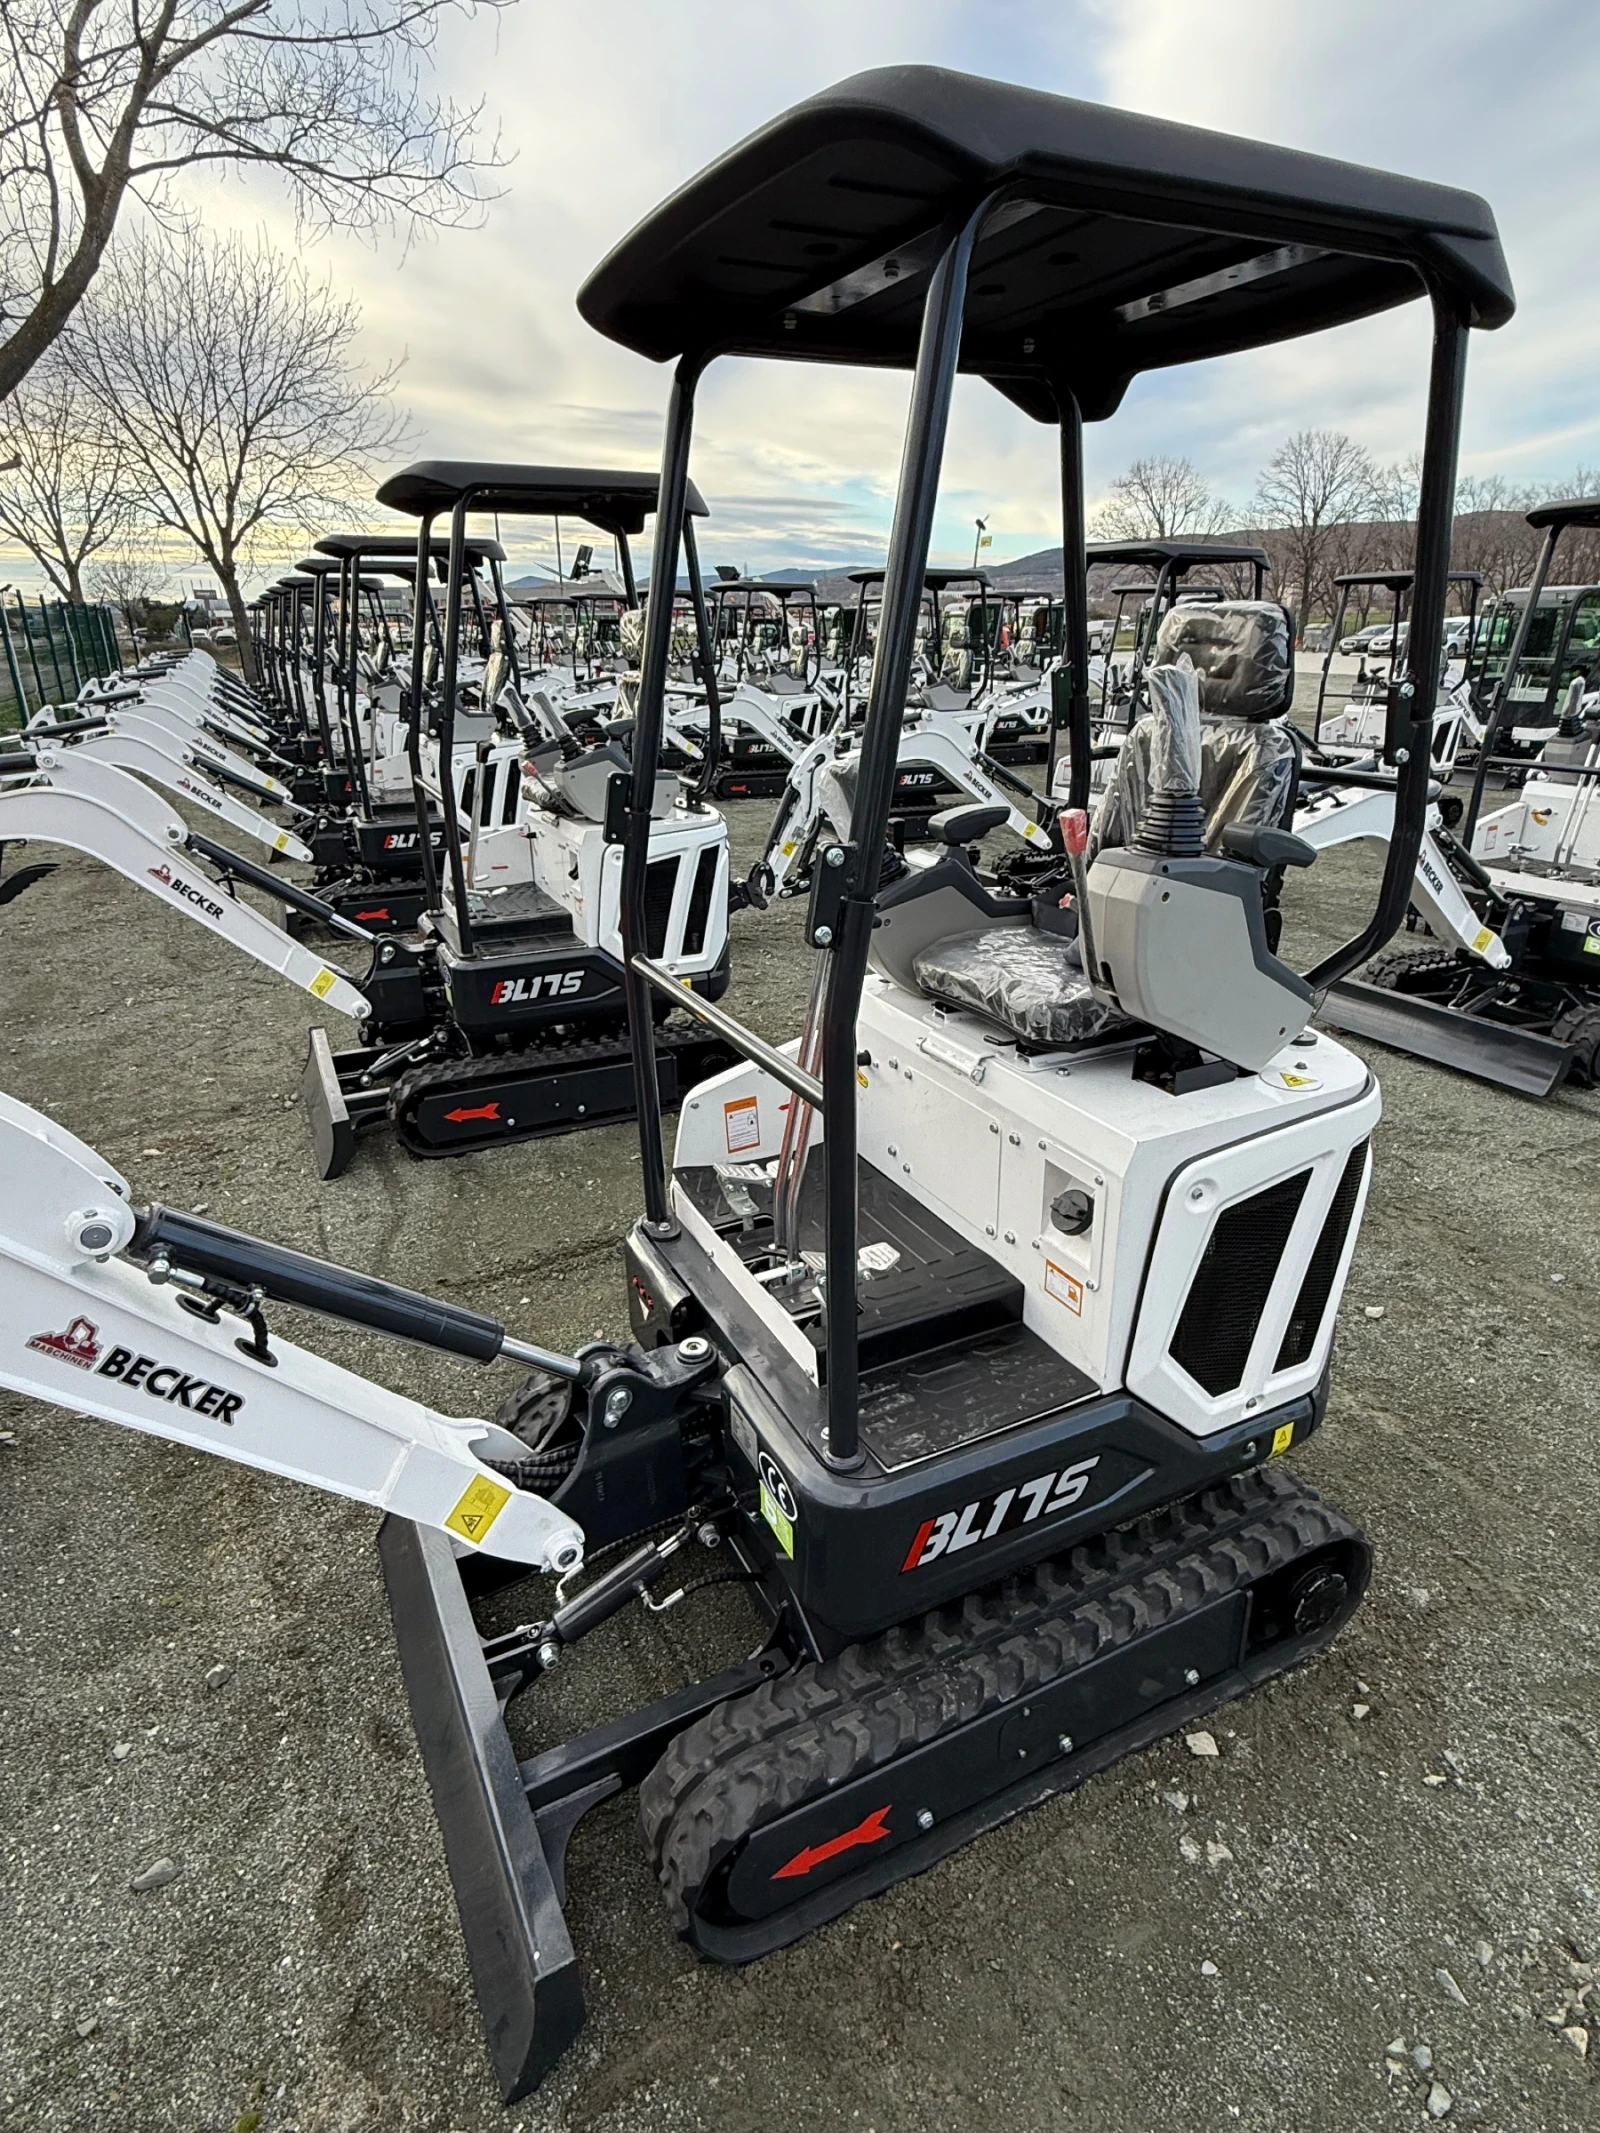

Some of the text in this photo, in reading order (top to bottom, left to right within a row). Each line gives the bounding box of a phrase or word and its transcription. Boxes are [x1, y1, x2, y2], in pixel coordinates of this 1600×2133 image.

[202, 743, 226, 761] BECKER
[899, 774, 933, 786] BL17S
[971, 778, 993, 799] BECKER
[190, 786, 222, 809] BECKER
[1422, 861, 1443, 895] BECKER
[170, 878, 224, 921] BECKER
[490, 970, 585, 1005] BL17S
[28, 1340, 93, 1369] MASCHINEN
[97, 1346, 245, 1426] BECKER
[767, 1467, 788, 1511] CE
[901, 1455, 1100, 1573] BL17S
